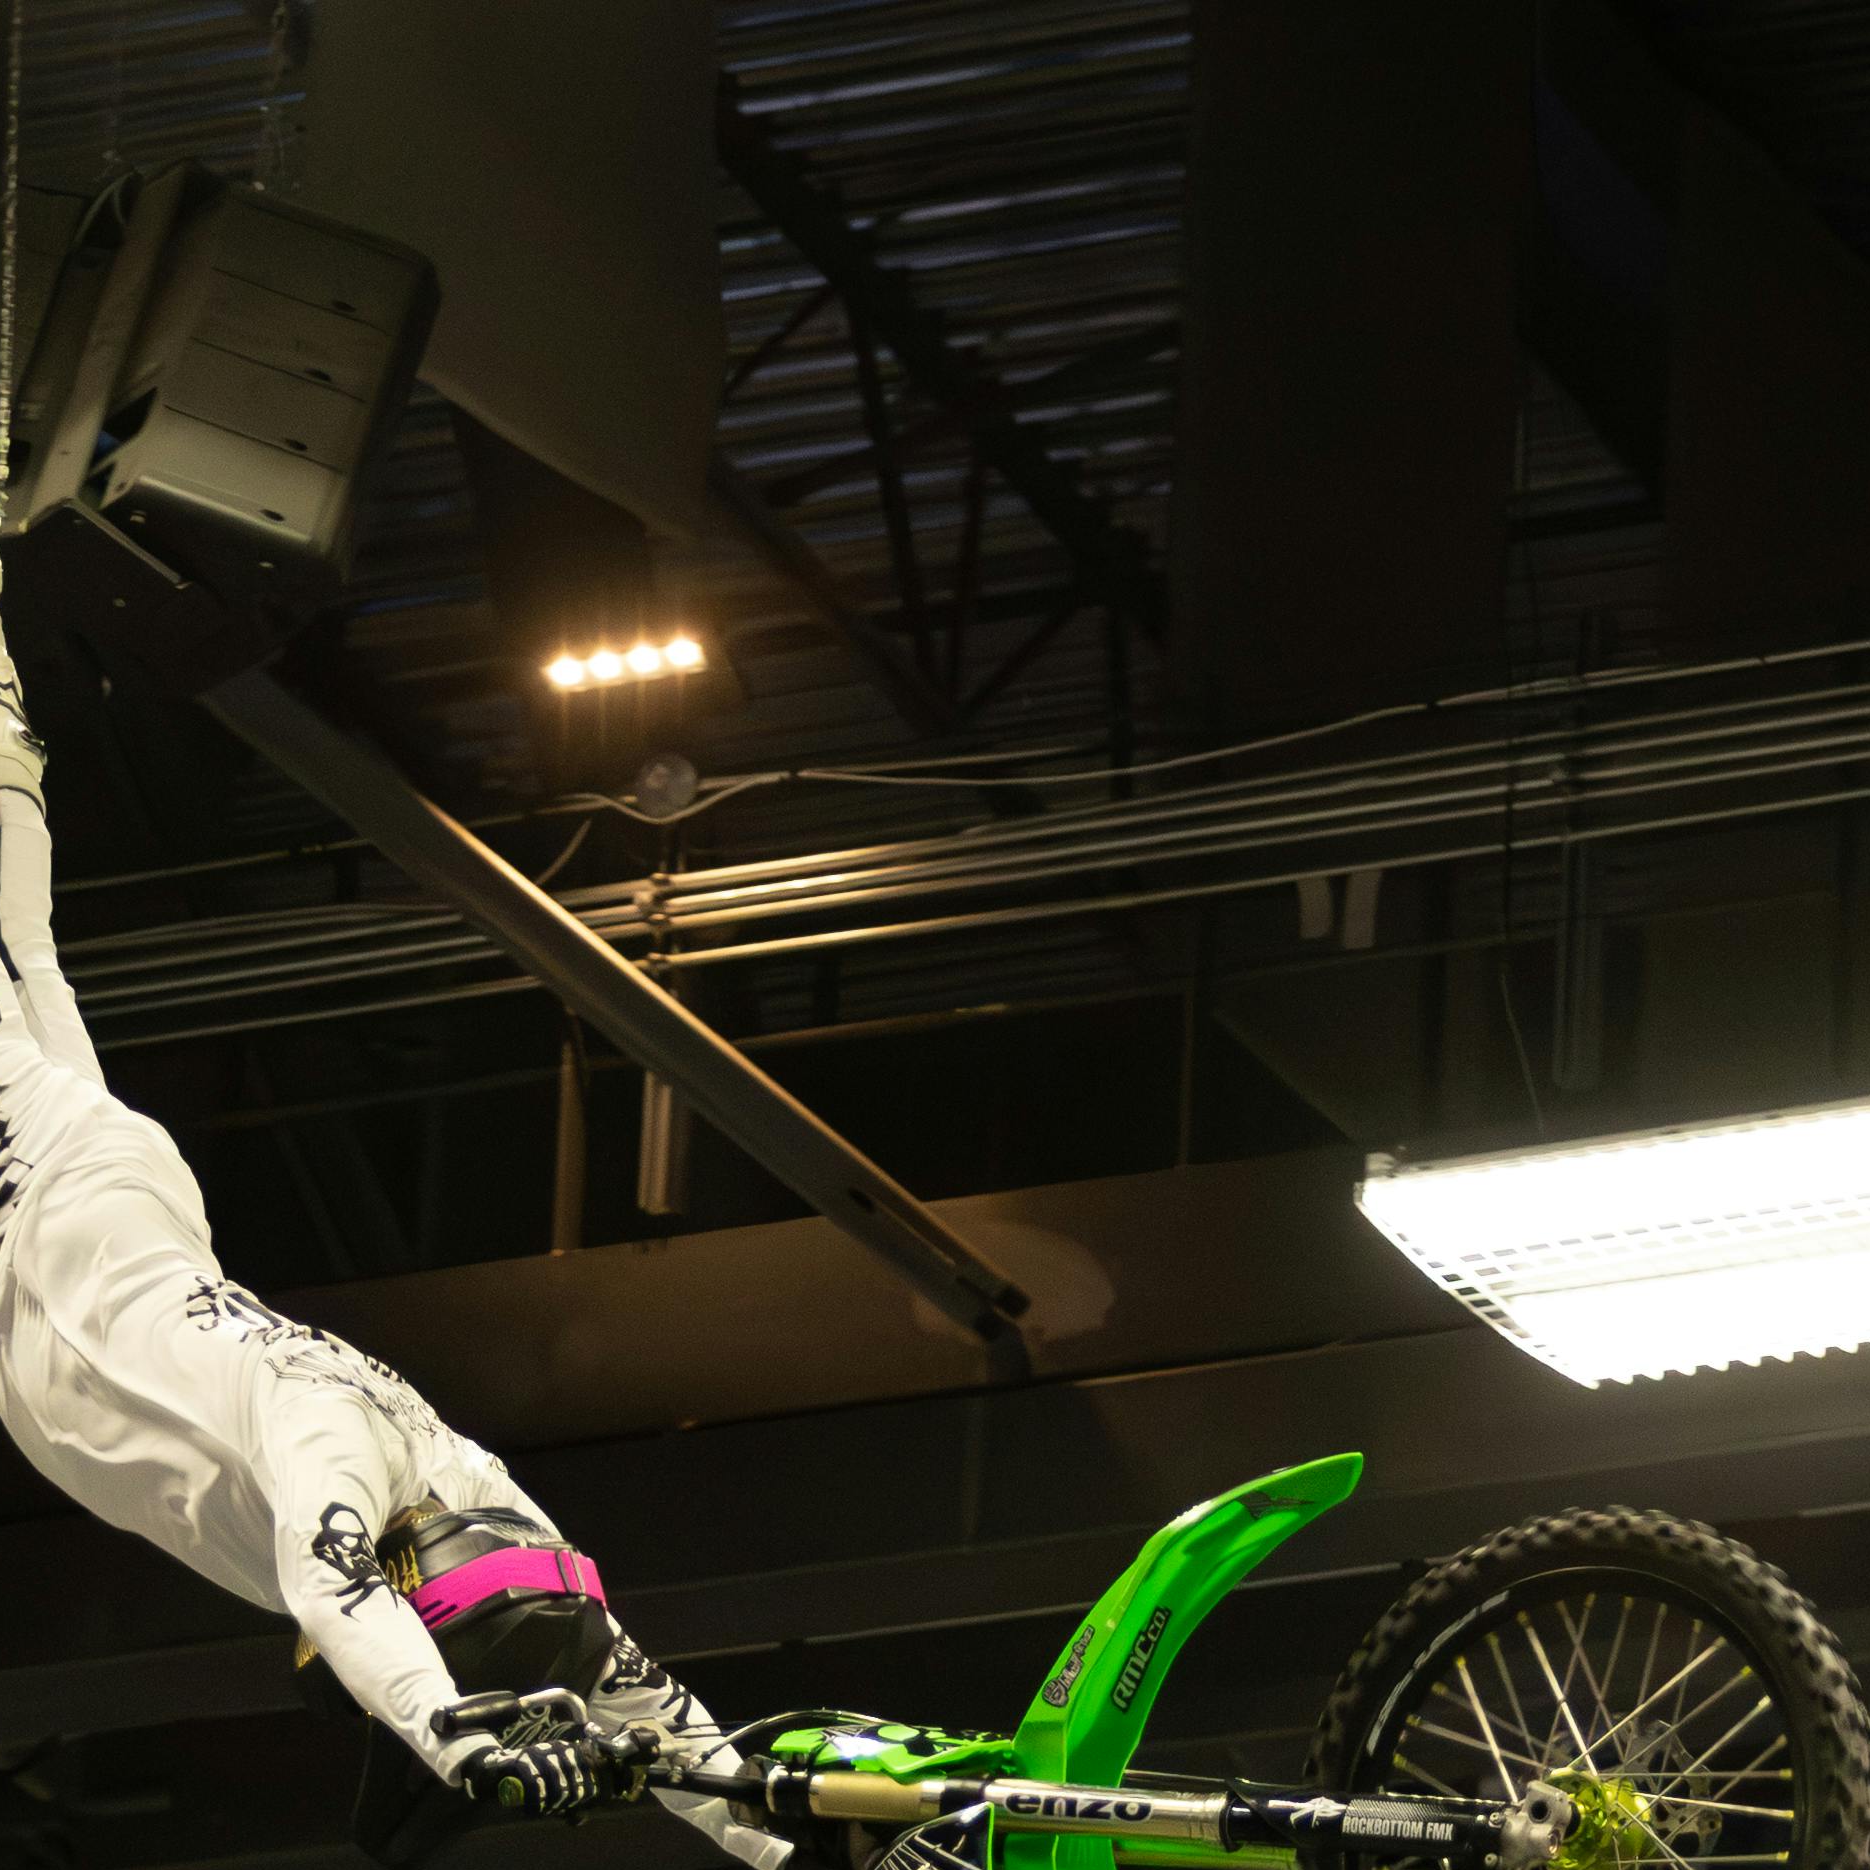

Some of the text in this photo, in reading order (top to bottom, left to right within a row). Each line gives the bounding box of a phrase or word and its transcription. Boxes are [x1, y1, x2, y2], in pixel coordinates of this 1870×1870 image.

[1003, 1790, 1152, 1823] enzo
[1342, 1816, 1454, 1841] ROCKBOTTOM FMX
